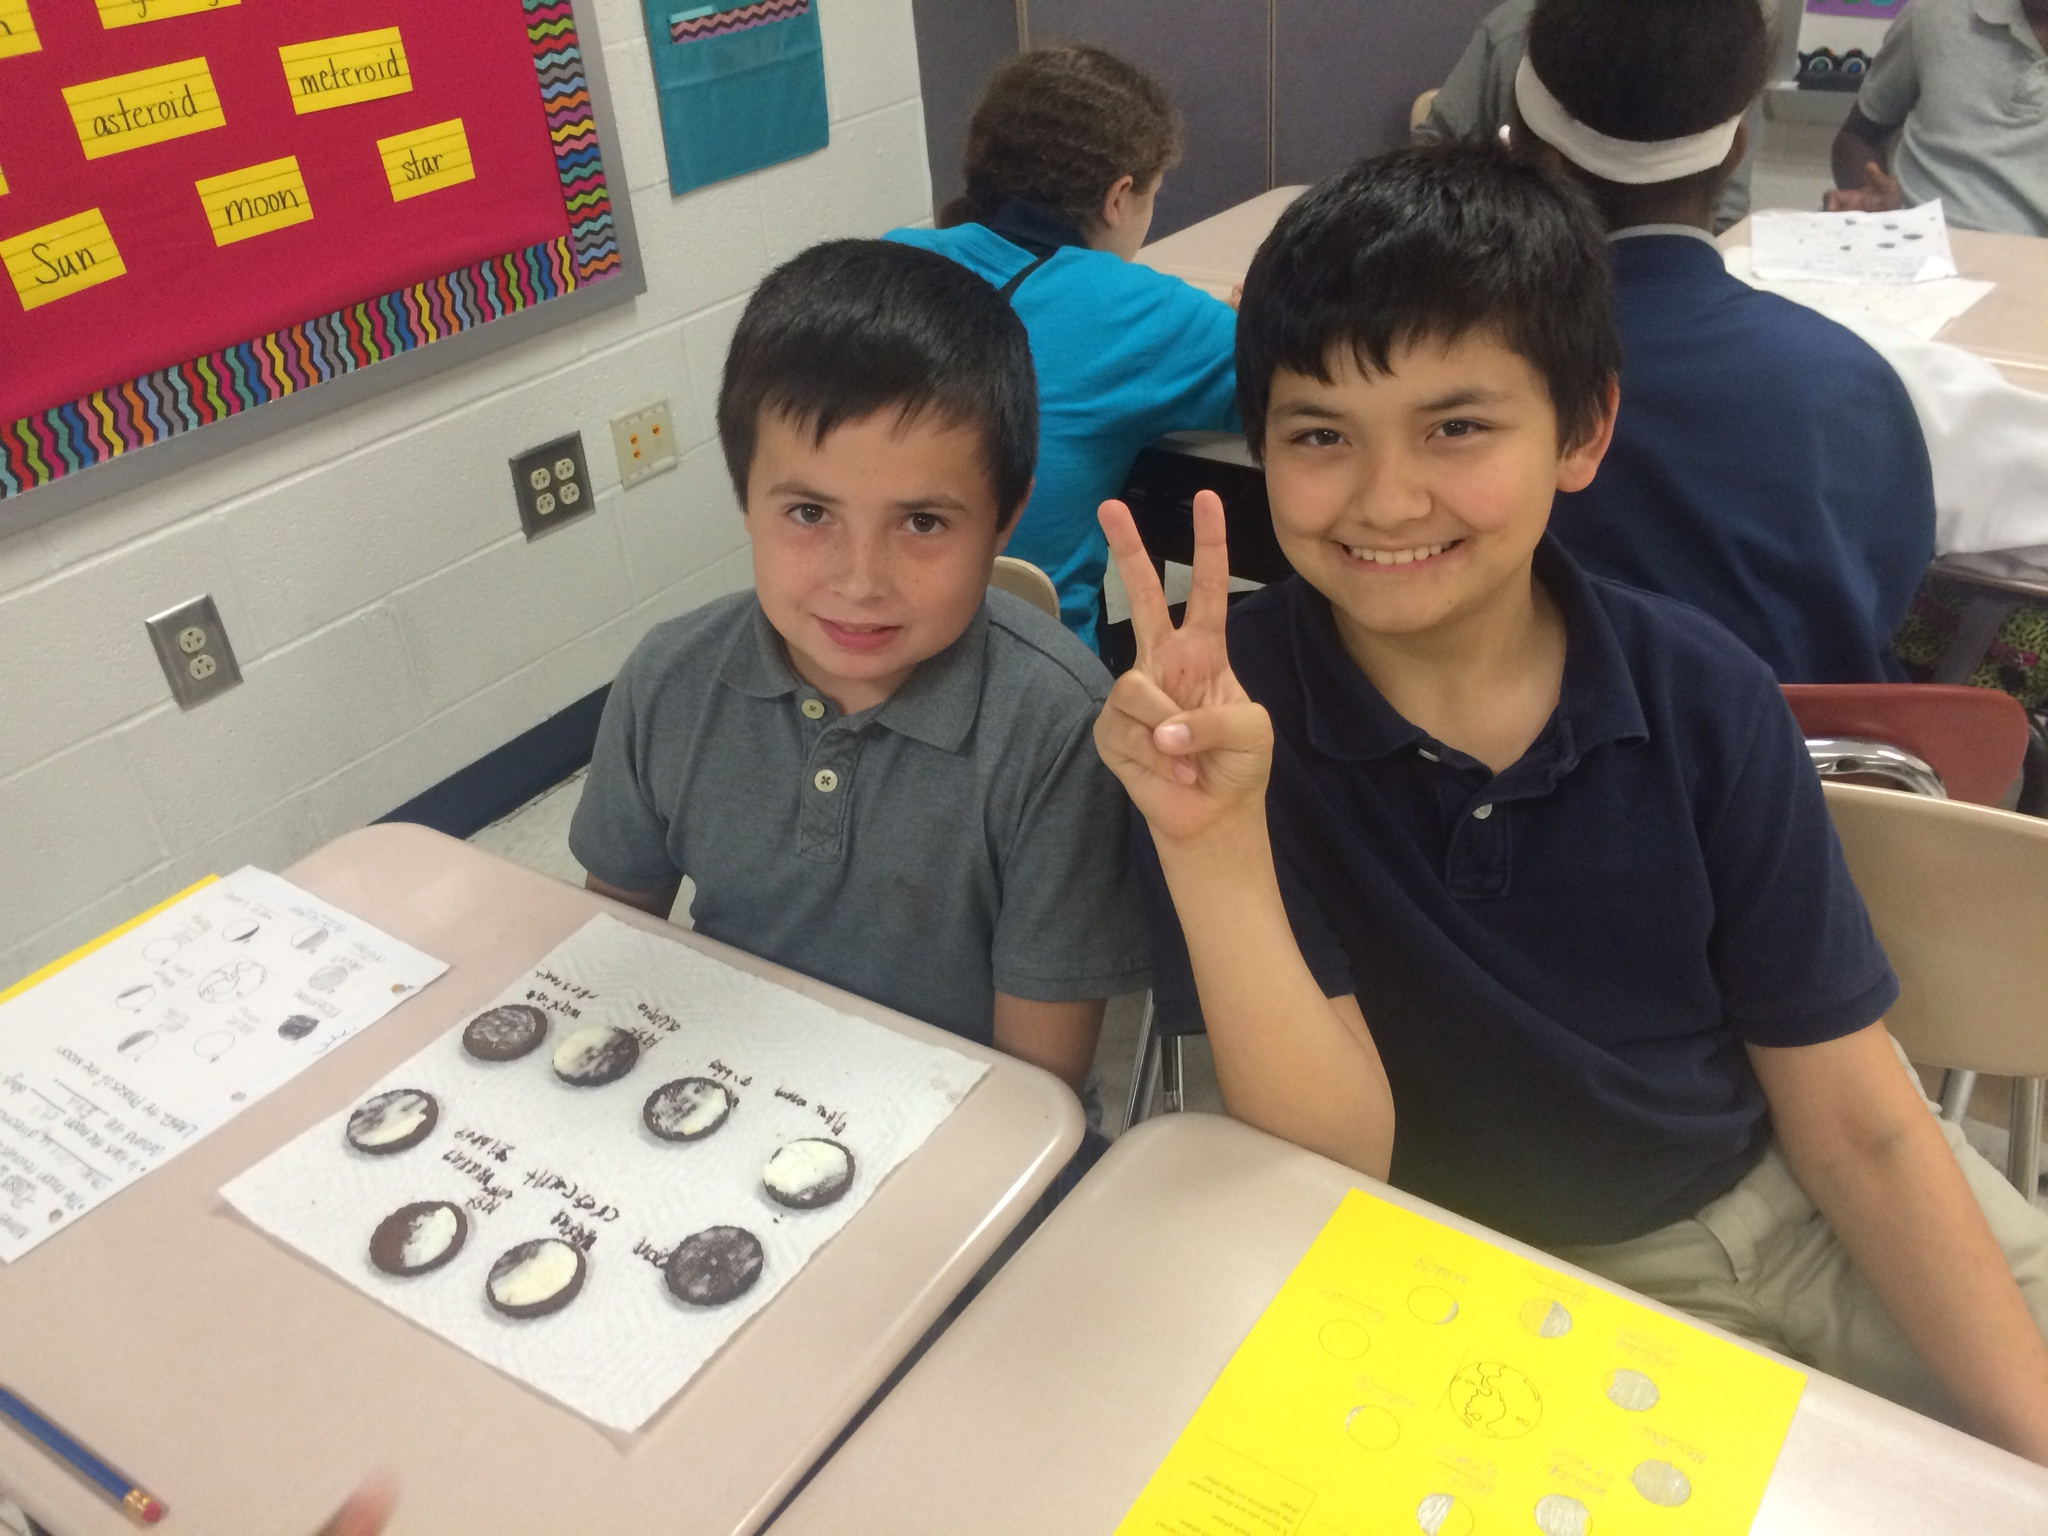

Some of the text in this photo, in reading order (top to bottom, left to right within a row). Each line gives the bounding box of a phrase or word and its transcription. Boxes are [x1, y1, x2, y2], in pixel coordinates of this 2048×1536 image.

[299, 47, 401, 96] meteroid
[93, 82, 199, 138] asteroid
[401, 149, 444, 182] star
[223, 187, 301, 226] moon
[31, 242, 97, 286] Sun
